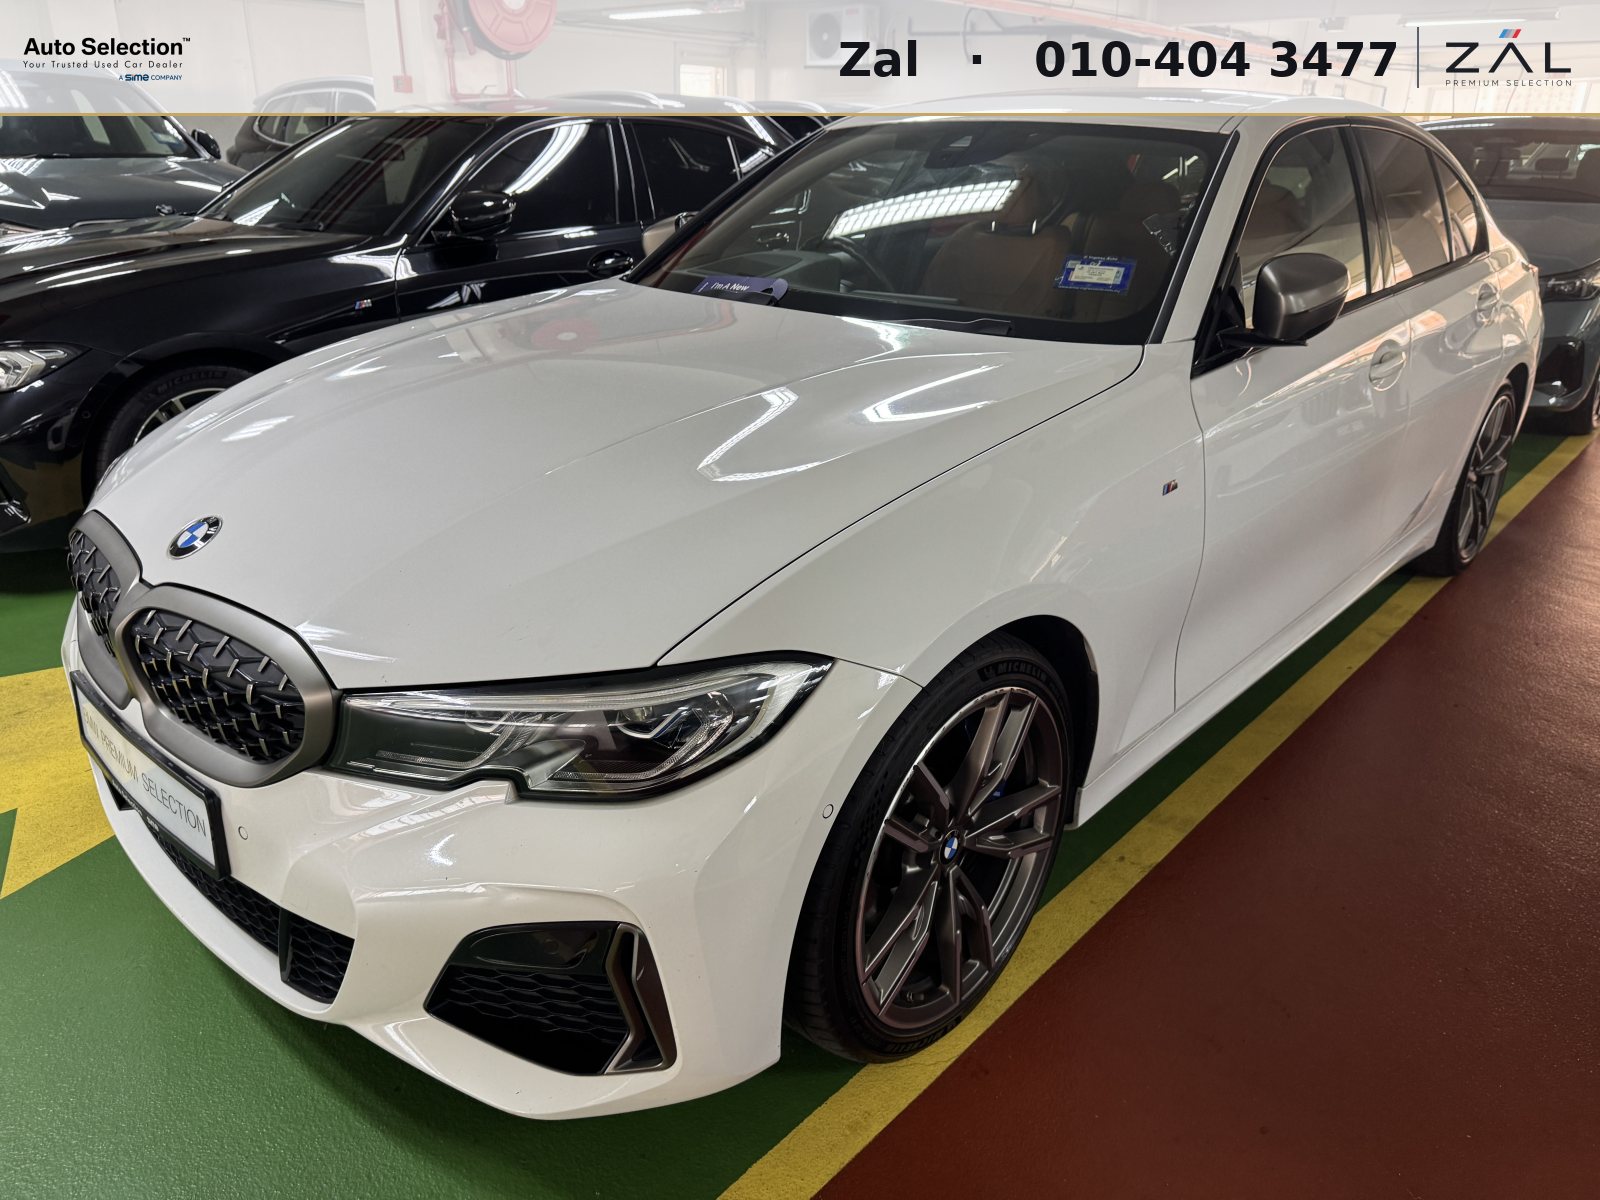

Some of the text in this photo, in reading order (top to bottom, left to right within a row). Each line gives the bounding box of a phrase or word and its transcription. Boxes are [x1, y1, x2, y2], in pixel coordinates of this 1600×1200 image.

[721, 282, 731, 290] A
[729, 283, 750, 291] New
[997, 661, 1048, 682] MICHELIN
[99, 729, 140, 783] PREMIUM
[140, 771, 207, 838] SELECTION
